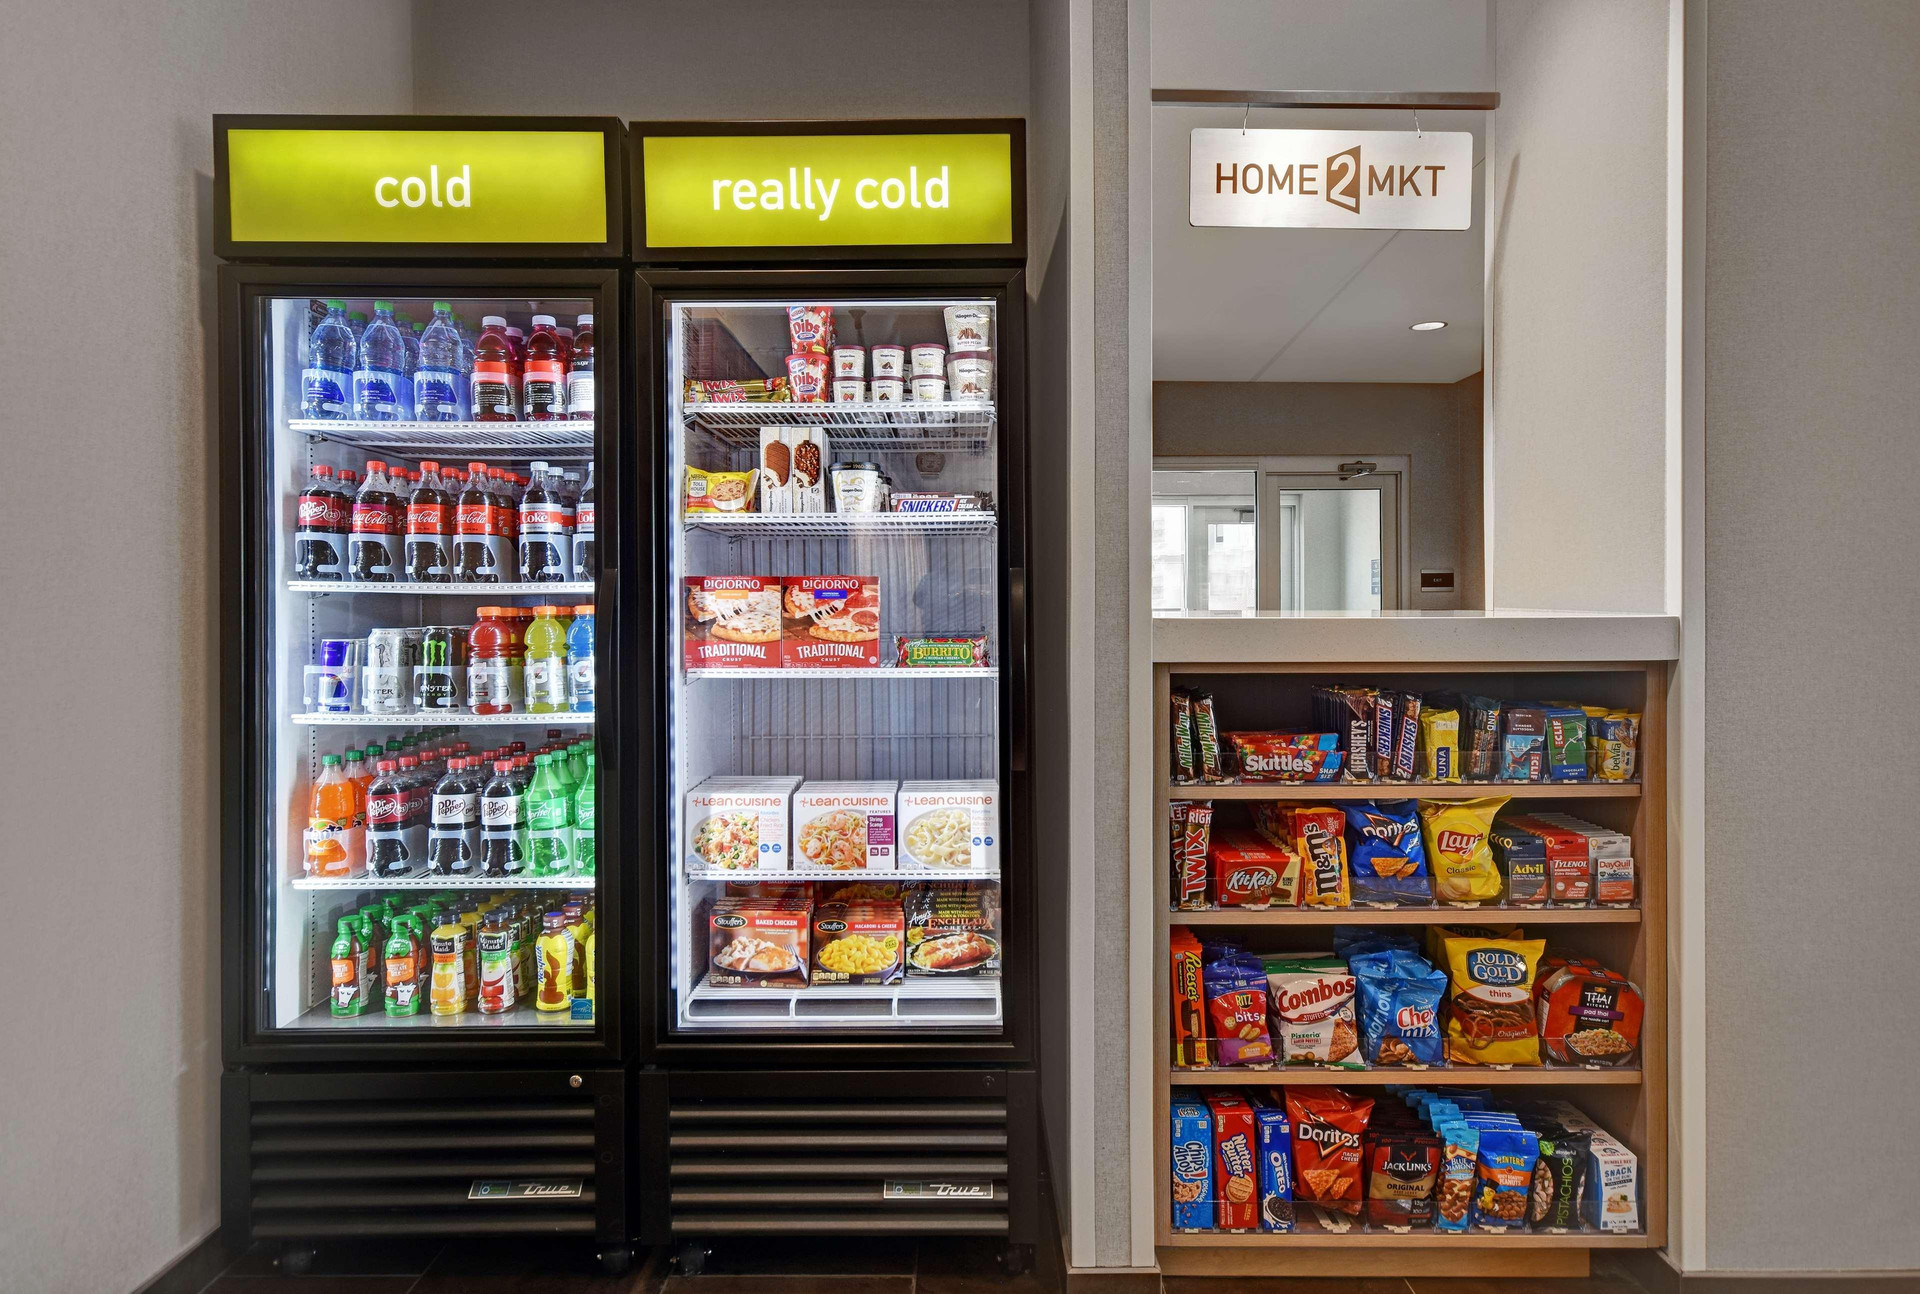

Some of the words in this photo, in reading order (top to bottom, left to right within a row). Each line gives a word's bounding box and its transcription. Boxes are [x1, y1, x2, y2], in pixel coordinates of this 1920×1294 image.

[375, 164, 471, 208] cold
[712, 166, 841, 221] really
[855, 165, 949, 209] cold
[793, 319, 820, 335] Dibs
[794, 371, 820, 387] Dibs
[900, 499, 955, 512] SNICKERS
[577, 511, 595, 523] Cok
[698, 643, 766, 659] TRADITIONAL
[797, 643, 865, 659] TRADITIONAL
[912, 647, 970, 660] BURRITO
[1377, 707, 1392, 758] SNICKERS
[1552, 719, 1563, 742] CLIF
[1350, 719, 1368, 772] HERSHEY'S
[1399, 717, 1417, 771] SATISFIES
[1245, 754, 1314, 773] Skittles
[1438, 749, 1447, 779] LUNA
[438, 801, 464, 816] Pepper
[444, 798, 455, 807] Dr
[488, 800, 499, 809] Dr
[579, 808, 595, 818] Spri
[1188, 811, 1211, 824] RIGH
[1180, 828, 1207, 900] TWIX
[1446, 865, 1476, 875] Classic
[1512, 864, 1544, 874] Advil
[1554, 860, 1588, 868] TYLENOL
[1600, 861, 1631, 870] DayQuil
[928, 917, 994, 930] ENCHILADA
[1476, 951, 1516, 966] ROLD
[1184, 950, 1202, 1002] Reese's
[1473, 964, 1522, 981] GOLD
[1235, 994, 1253, 1007] RITZ
[1278, 977, 1356, 1013] Combos
[1489, 990, 1512, 998] thins
[1584, 991, 1612, 1005] THAI
[1235, 1012, 1260, 1022] bits
[1497, 1028, 1528, 1039] Original
[1299, 1123, 1360, 1147] Doritos
[1185, 1141, 1205, 1172] Chips
[1221, 1140, 1244, 1179] Butter
[1231, 1133, 1253, 1173] Nutter
[1269, 1151, 1286, 1194] OREO
[1382, 1160, 1406, 1172] JACK
[1604, 1166, 1632, 1178] SNACK
[1386, 1183, 1425, 1192] ORIGINAL
[1557, 1157, 1574, 1226] PISTACHIOS
